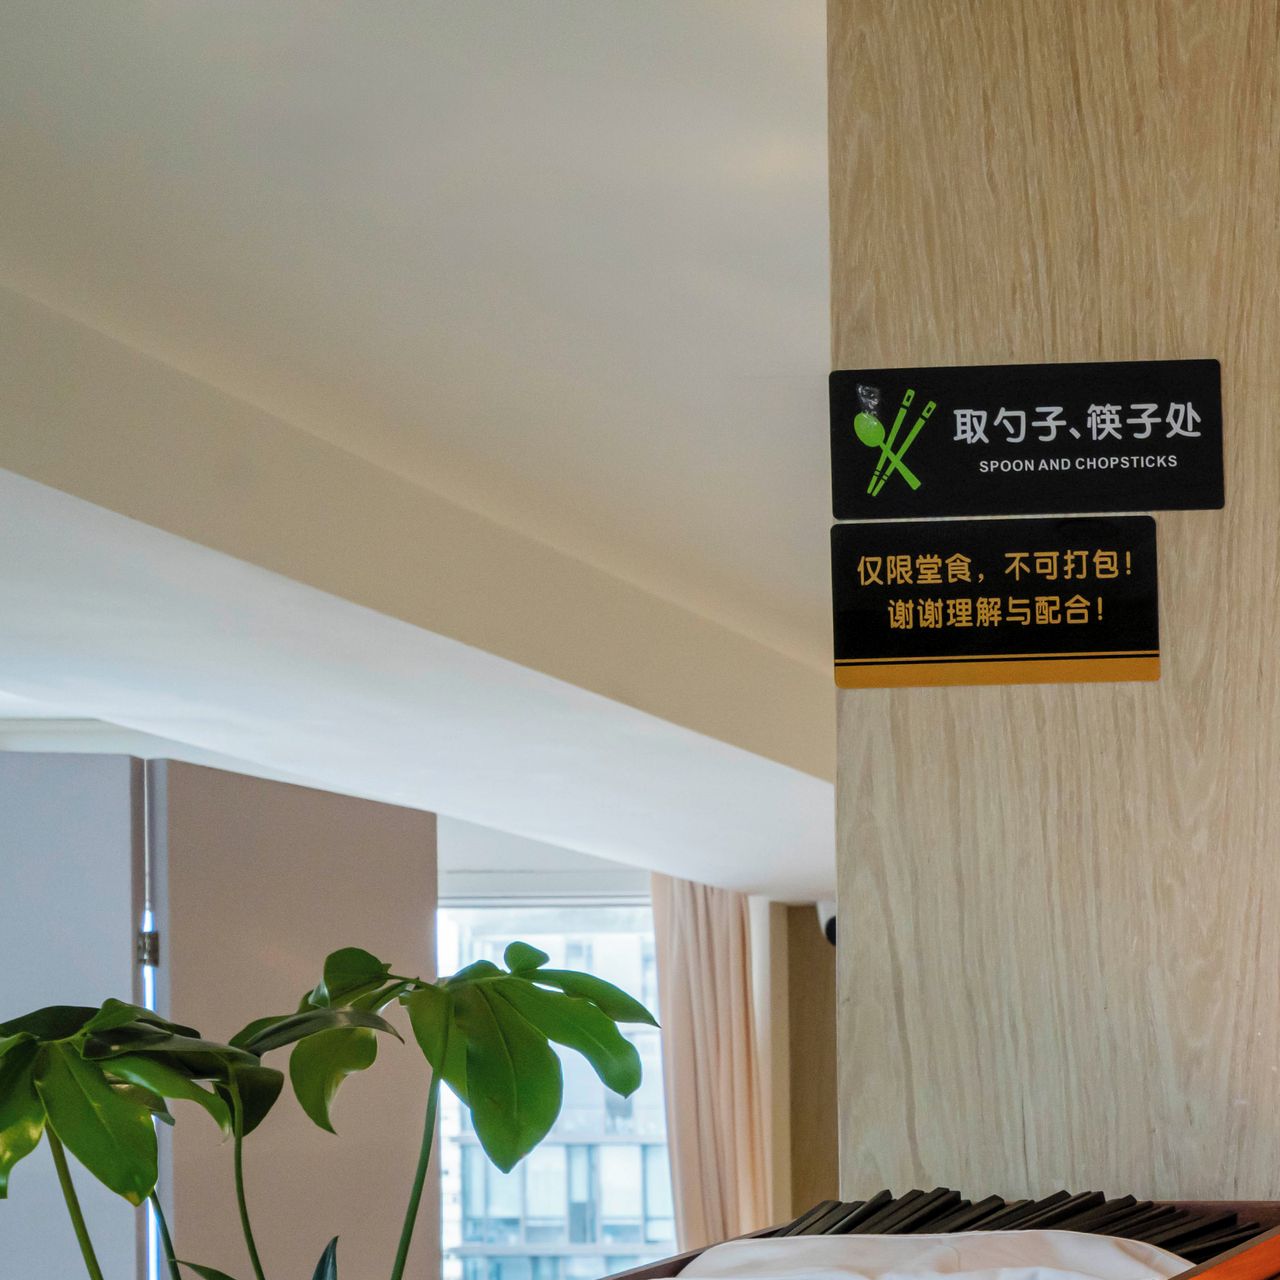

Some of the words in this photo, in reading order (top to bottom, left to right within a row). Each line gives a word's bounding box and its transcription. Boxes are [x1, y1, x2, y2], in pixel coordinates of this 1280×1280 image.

[953, 402, 1201, 444] 取勺子、筷子处
[979, 459, 1034, 473] SPOON
[1039, 458, 1071, 471] AND
[1075, 454, 1178, 470] CHOPSTICKS
